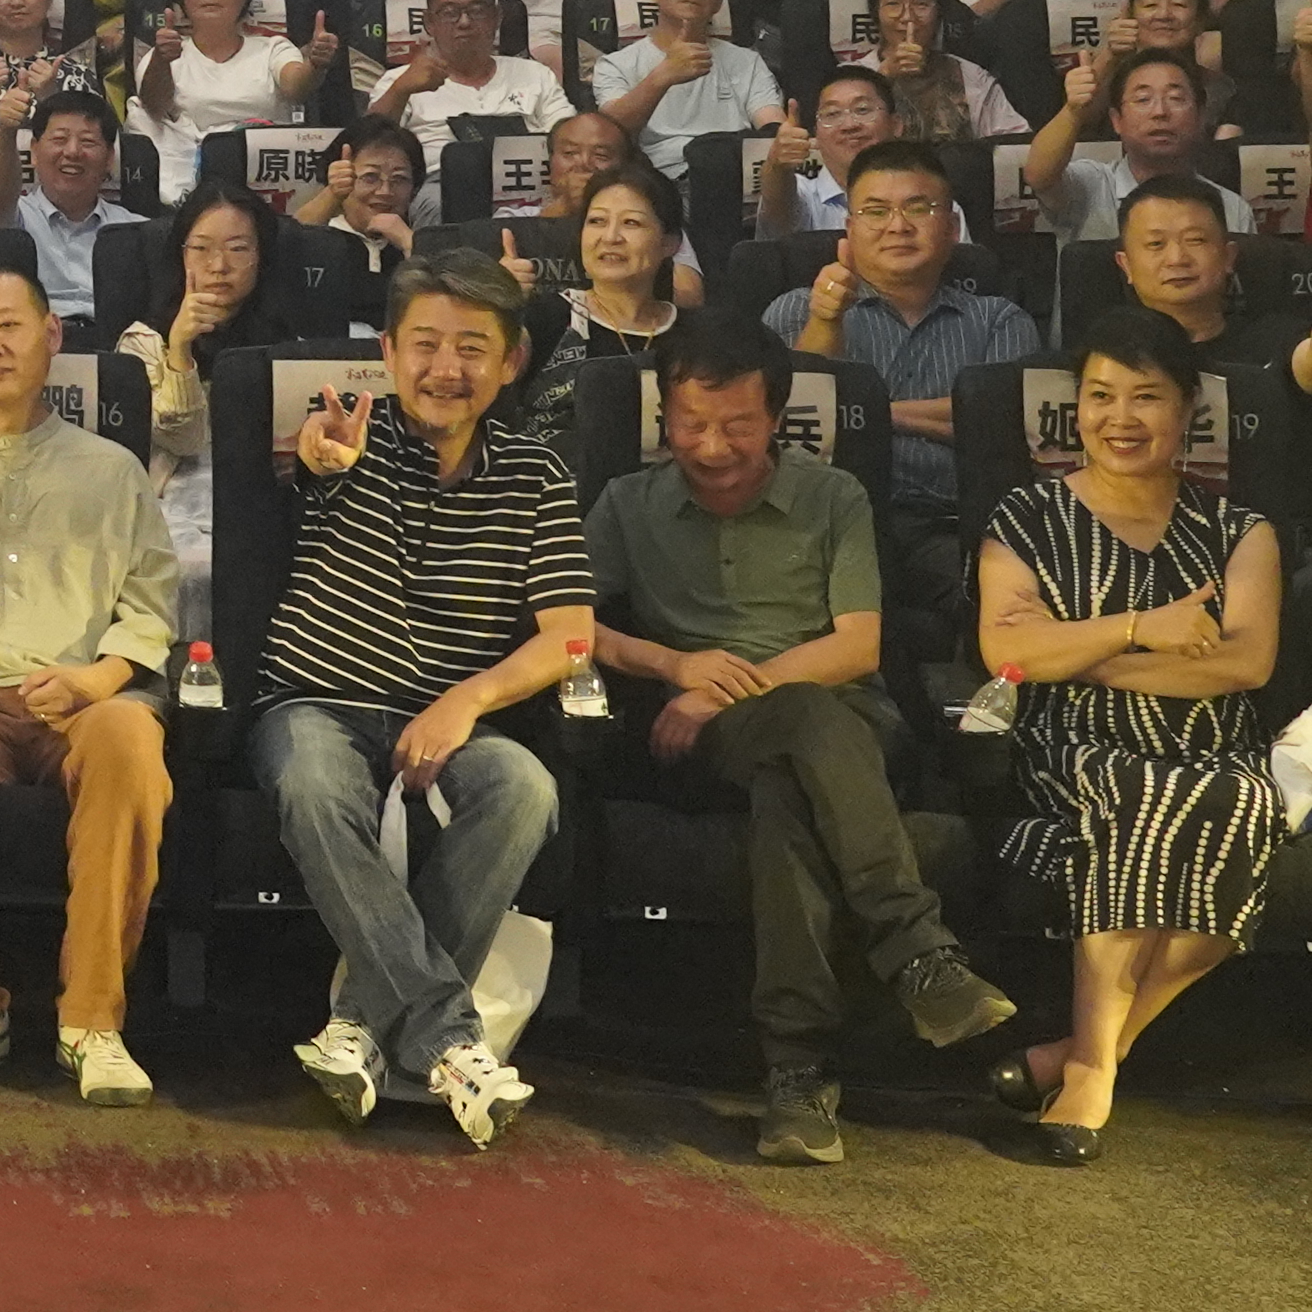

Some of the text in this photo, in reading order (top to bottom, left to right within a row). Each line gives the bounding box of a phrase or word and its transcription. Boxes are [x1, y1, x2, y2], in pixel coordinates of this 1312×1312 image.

[362, 23, 383, 37] 16
[590, 17, 611, 32] 17
[1069, 16, 1101, 47] 民
[1263, 167, 1298, 200] 王
[304, 266, 325, 289] 17
[99, 401, 124, 427] 16
[839, 404, 866, 430] 18
[1231, 413, 1260, 441] 19
